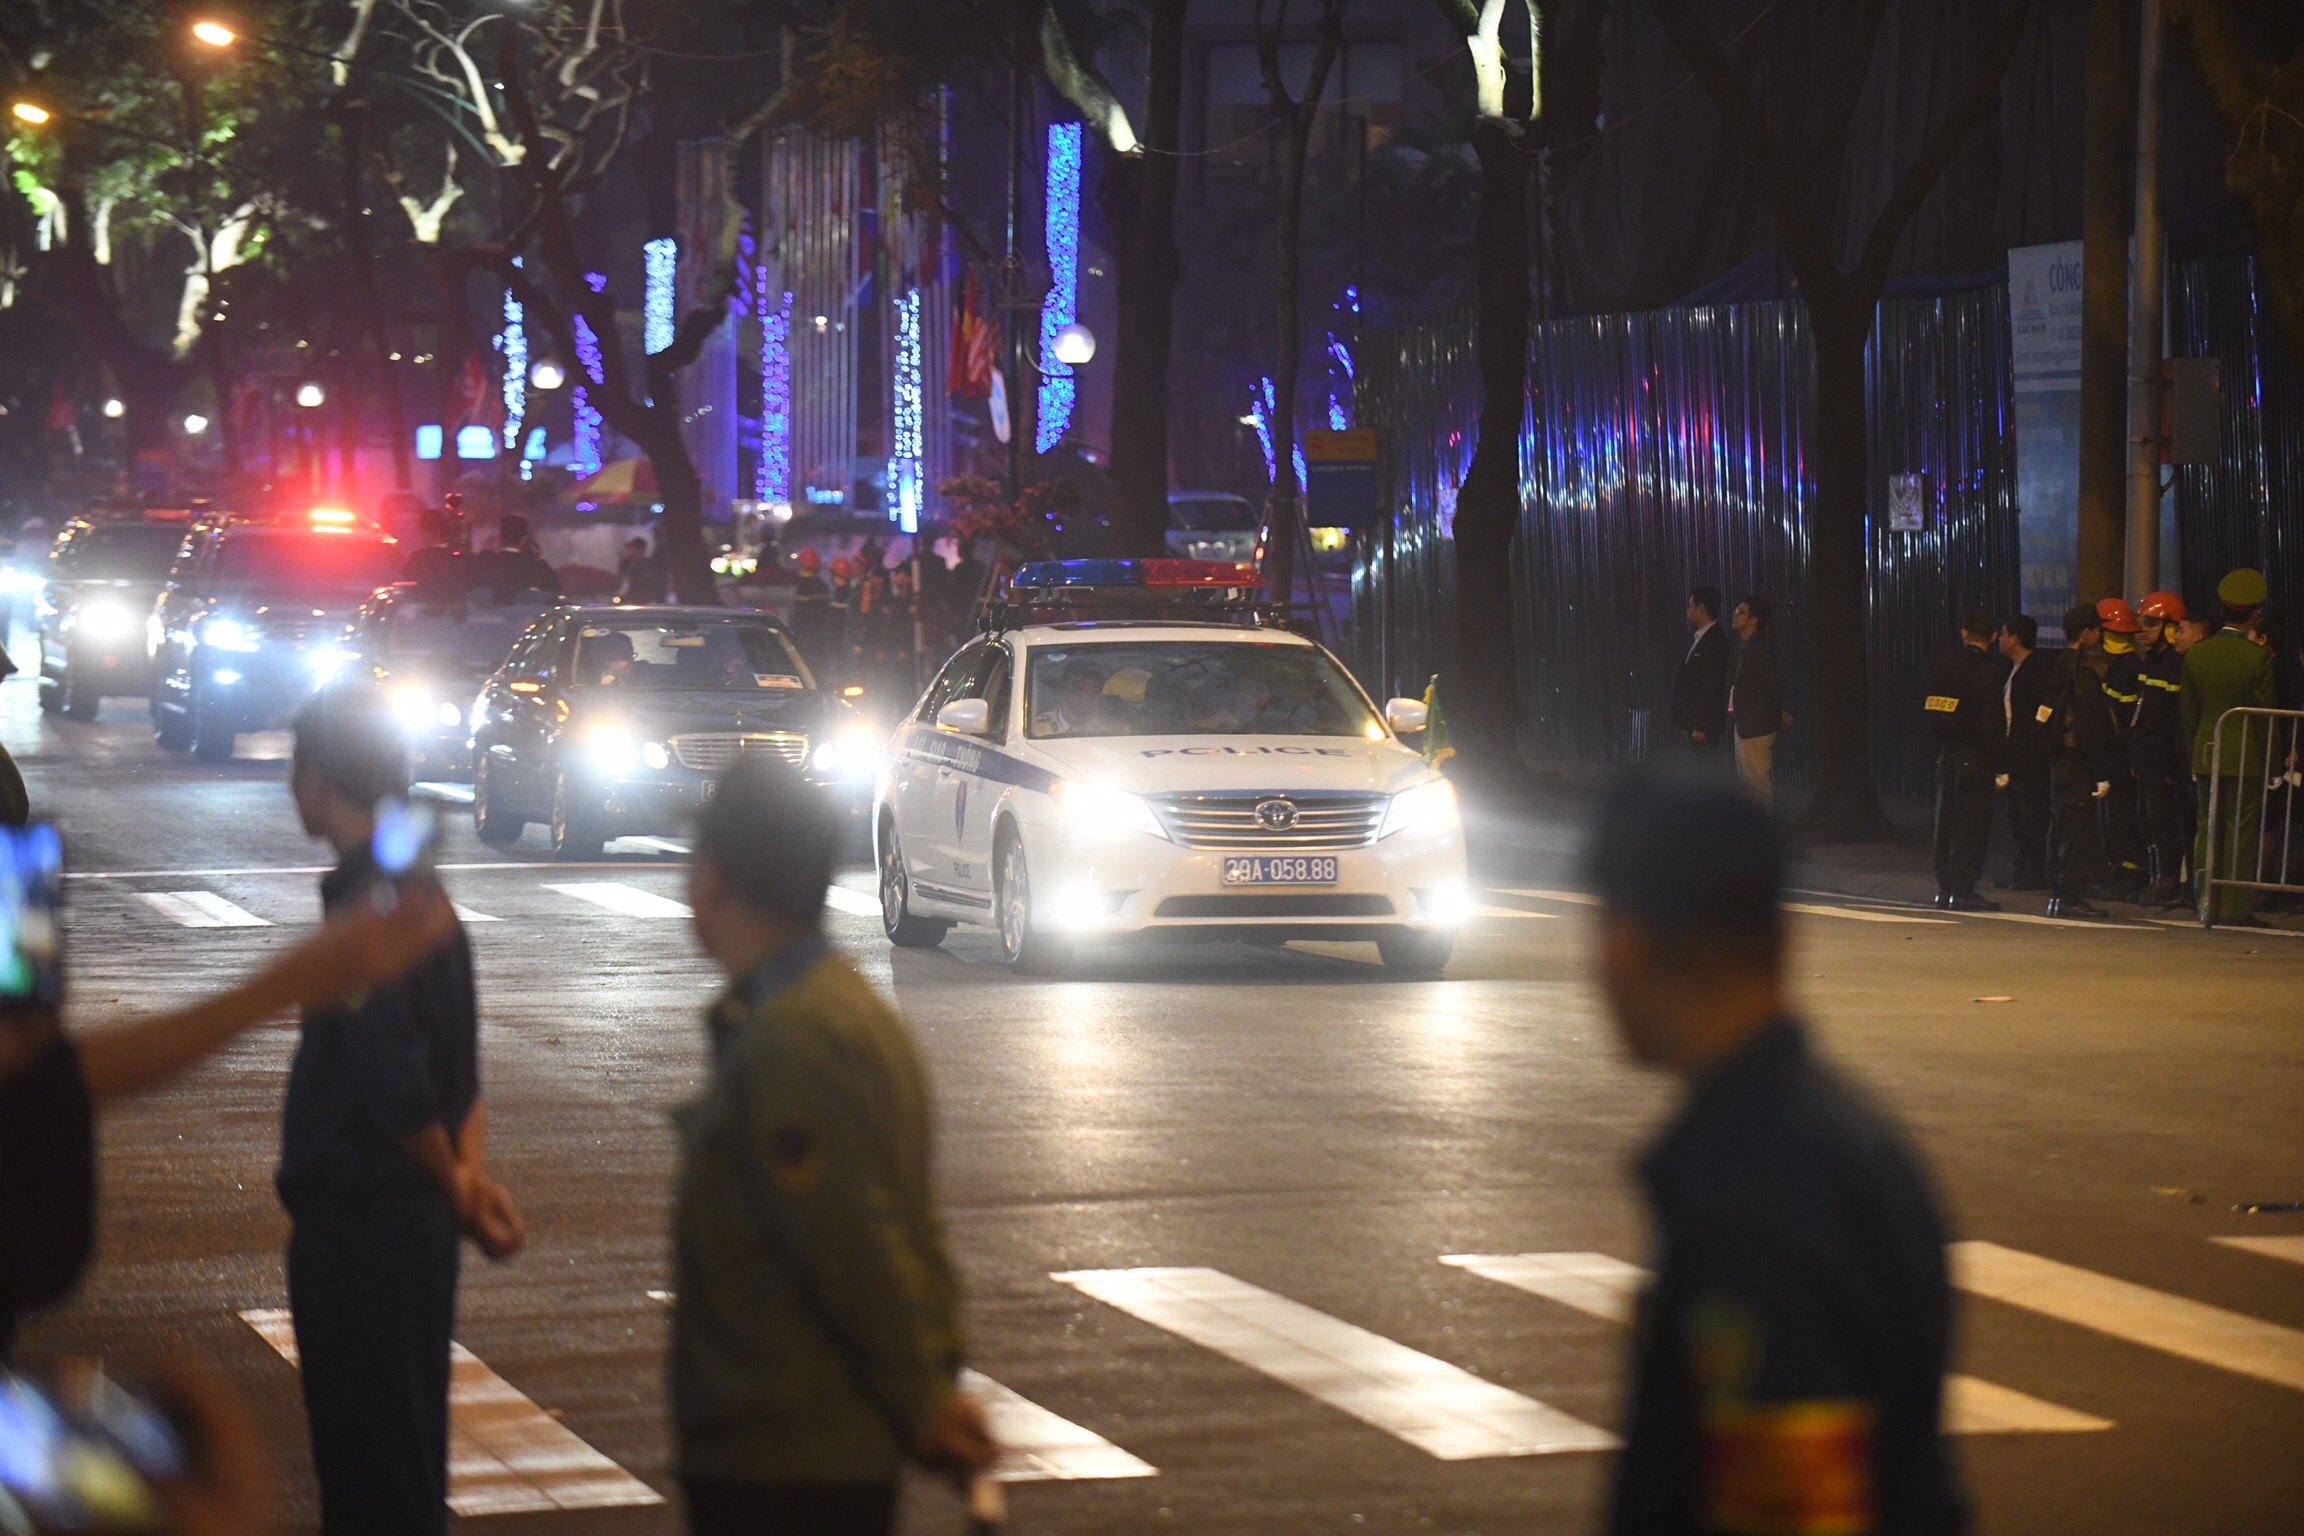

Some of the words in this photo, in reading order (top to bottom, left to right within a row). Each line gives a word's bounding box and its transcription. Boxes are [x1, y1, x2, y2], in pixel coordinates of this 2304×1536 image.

[1141, 746, 1352, 759] POLICE
[953, 862, 972, 880] POLICE
[1226, 858, 1336, 881] 29A-058.88
